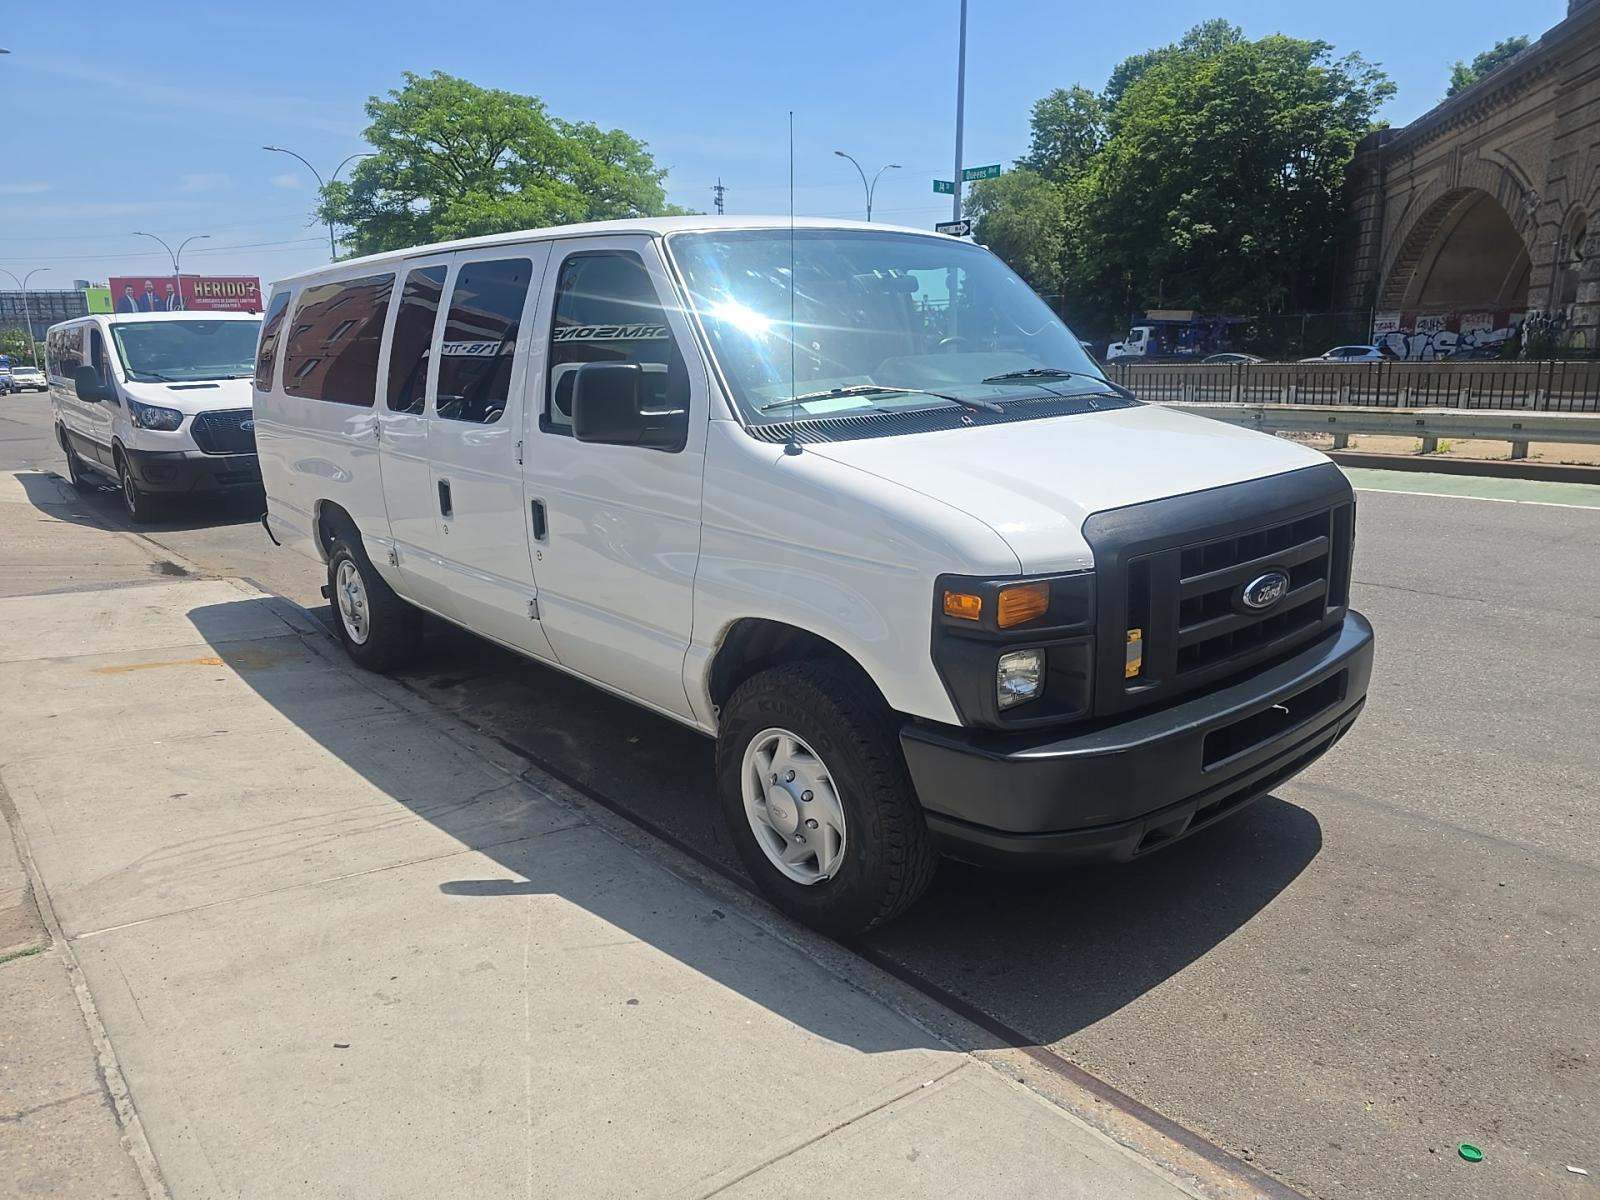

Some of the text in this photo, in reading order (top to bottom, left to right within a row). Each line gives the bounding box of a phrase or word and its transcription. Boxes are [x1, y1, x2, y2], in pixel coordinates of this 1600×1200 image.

[955, 224, 966, 232] WAY
[194, 281, 256, 297] HERIDO?
[1257, 580, 1283, 603] Ford
